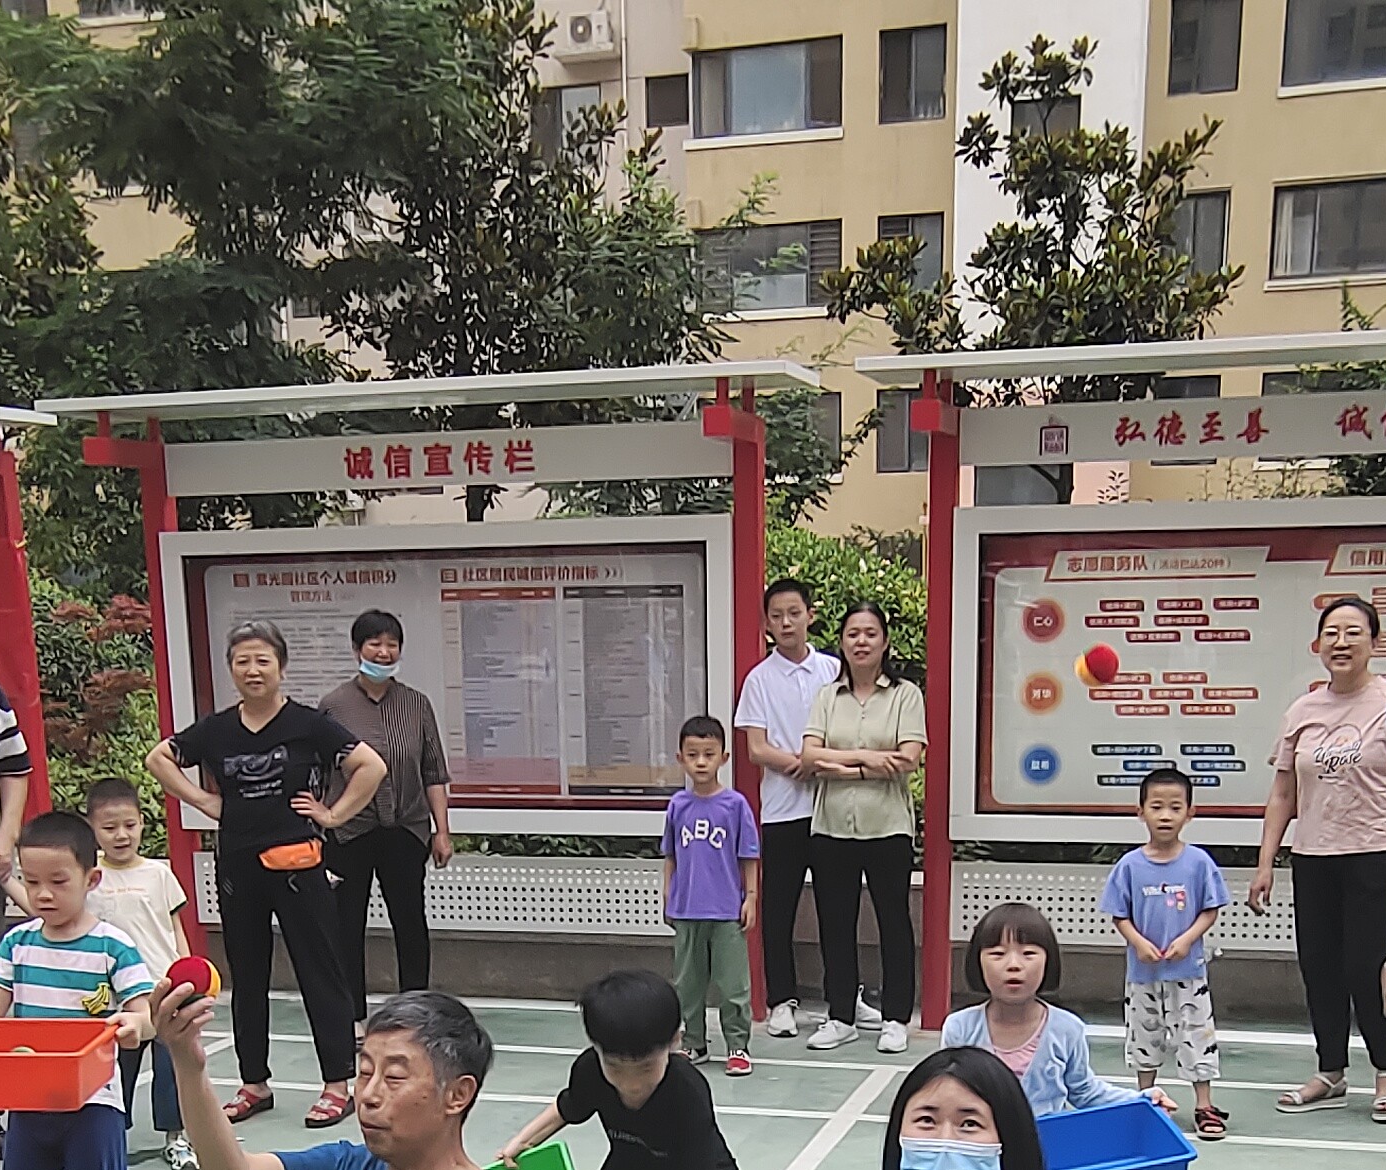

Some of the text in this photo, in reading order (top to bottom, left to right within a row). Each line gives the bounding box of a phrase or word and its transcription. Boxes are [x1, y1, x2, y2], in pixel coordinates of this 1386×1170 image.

[1114, 407, 1270, 448] 弘德至善
[343, 439, 536, 480] 诚信宣传栏
[681, 818, 727, 849] ABC
